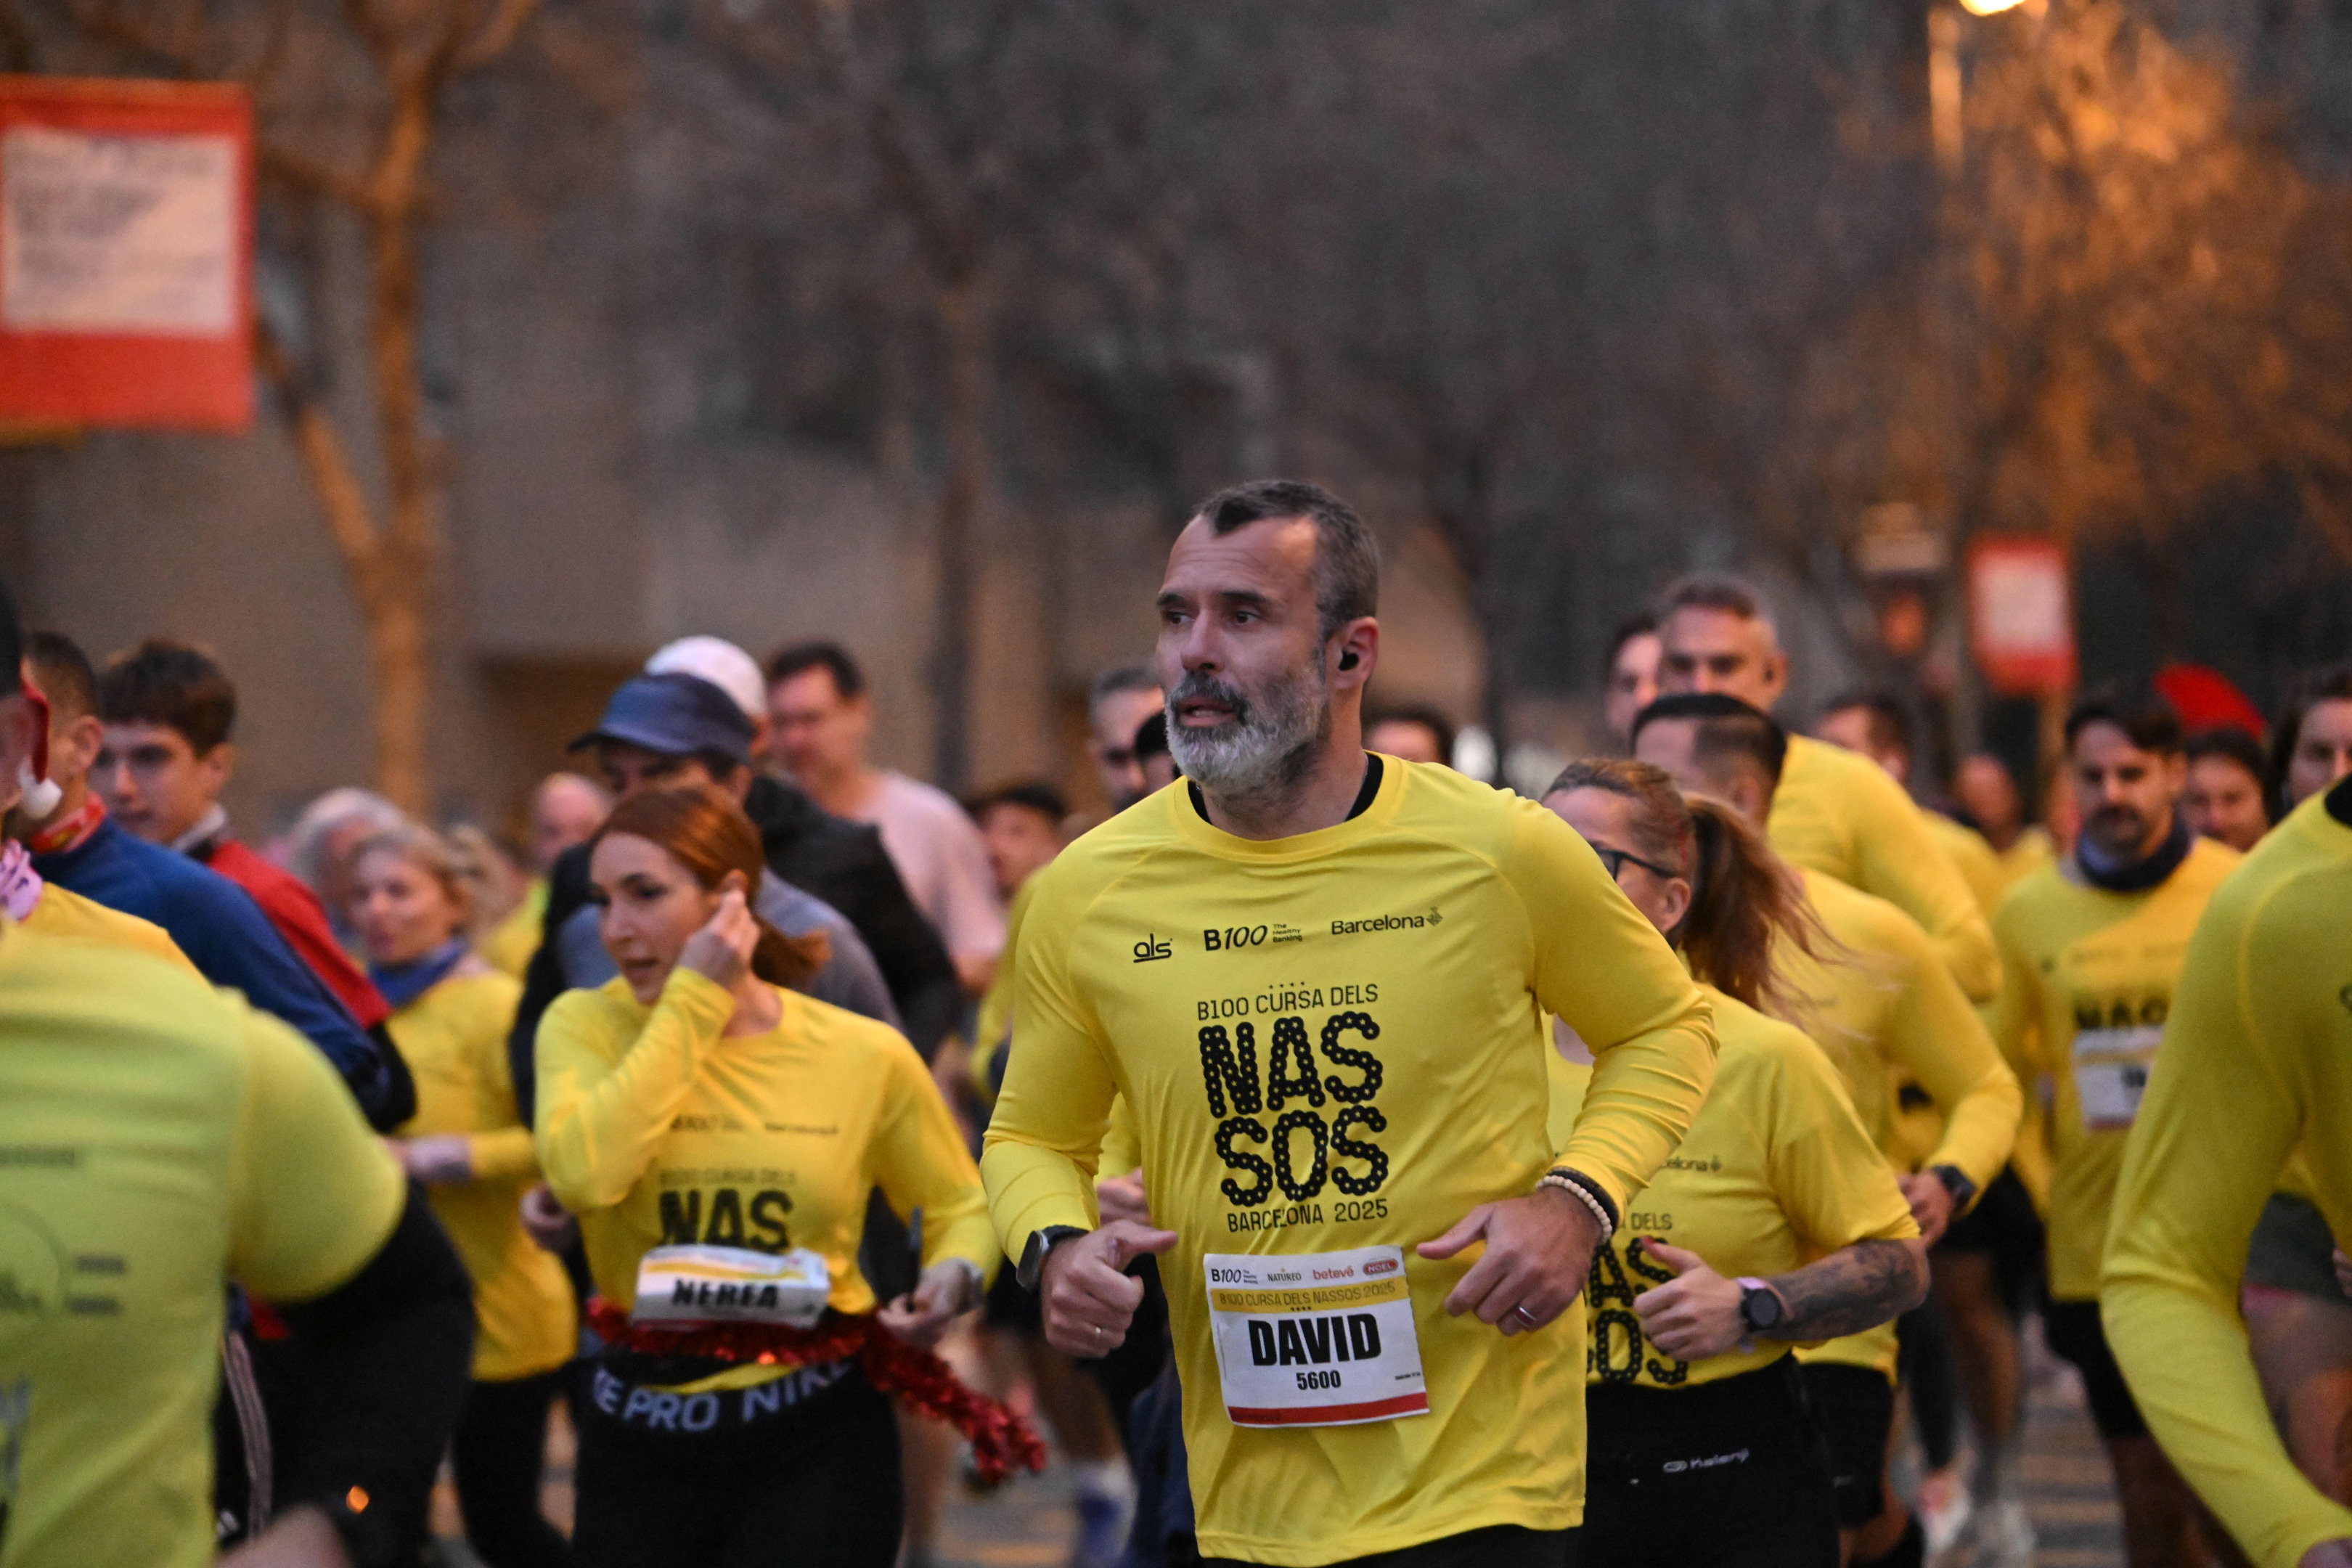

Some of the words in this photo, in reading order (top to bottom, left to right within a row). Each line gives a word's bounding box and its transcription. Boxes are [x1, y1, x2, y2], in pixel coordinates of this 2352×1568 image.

[1204, 925, 1267, 951] B100
[1331, 915, 1425, 935] Barcelona
[1133, 933, 1173, 964] als
[1197, 997, 1249, 1021] B100
[1256, 990, 1324, 1014] CURSA
[1330, 984, 1379, 1006] DELS
[1199, 1011, 1383, 1118] NAS
[1214, 1105, 1389, 1206] SOS
[659, 1188, 794, 1254] NAS
[1227, 1204, 1323, 1233] BARCELONA
[1334, 1199, 1388, 1222] 2025
[1630, 1212, 1673, 1230] DELS
[1211, 1268, 1241, 1283] B100
[1267, 1272, 1302, 1282] NATUREO
[1246, 1292, 1281, 1307] CURSA
[1283, 1291, 1311, 1306] DELS
[1312, 1287, 1362, 1304] NASSOS
[1248, 1313, 1381, 1366] DAVID
[1296, 1370, 1342, 1390] 5600
[624, 1387, 720, 1432] PRO
